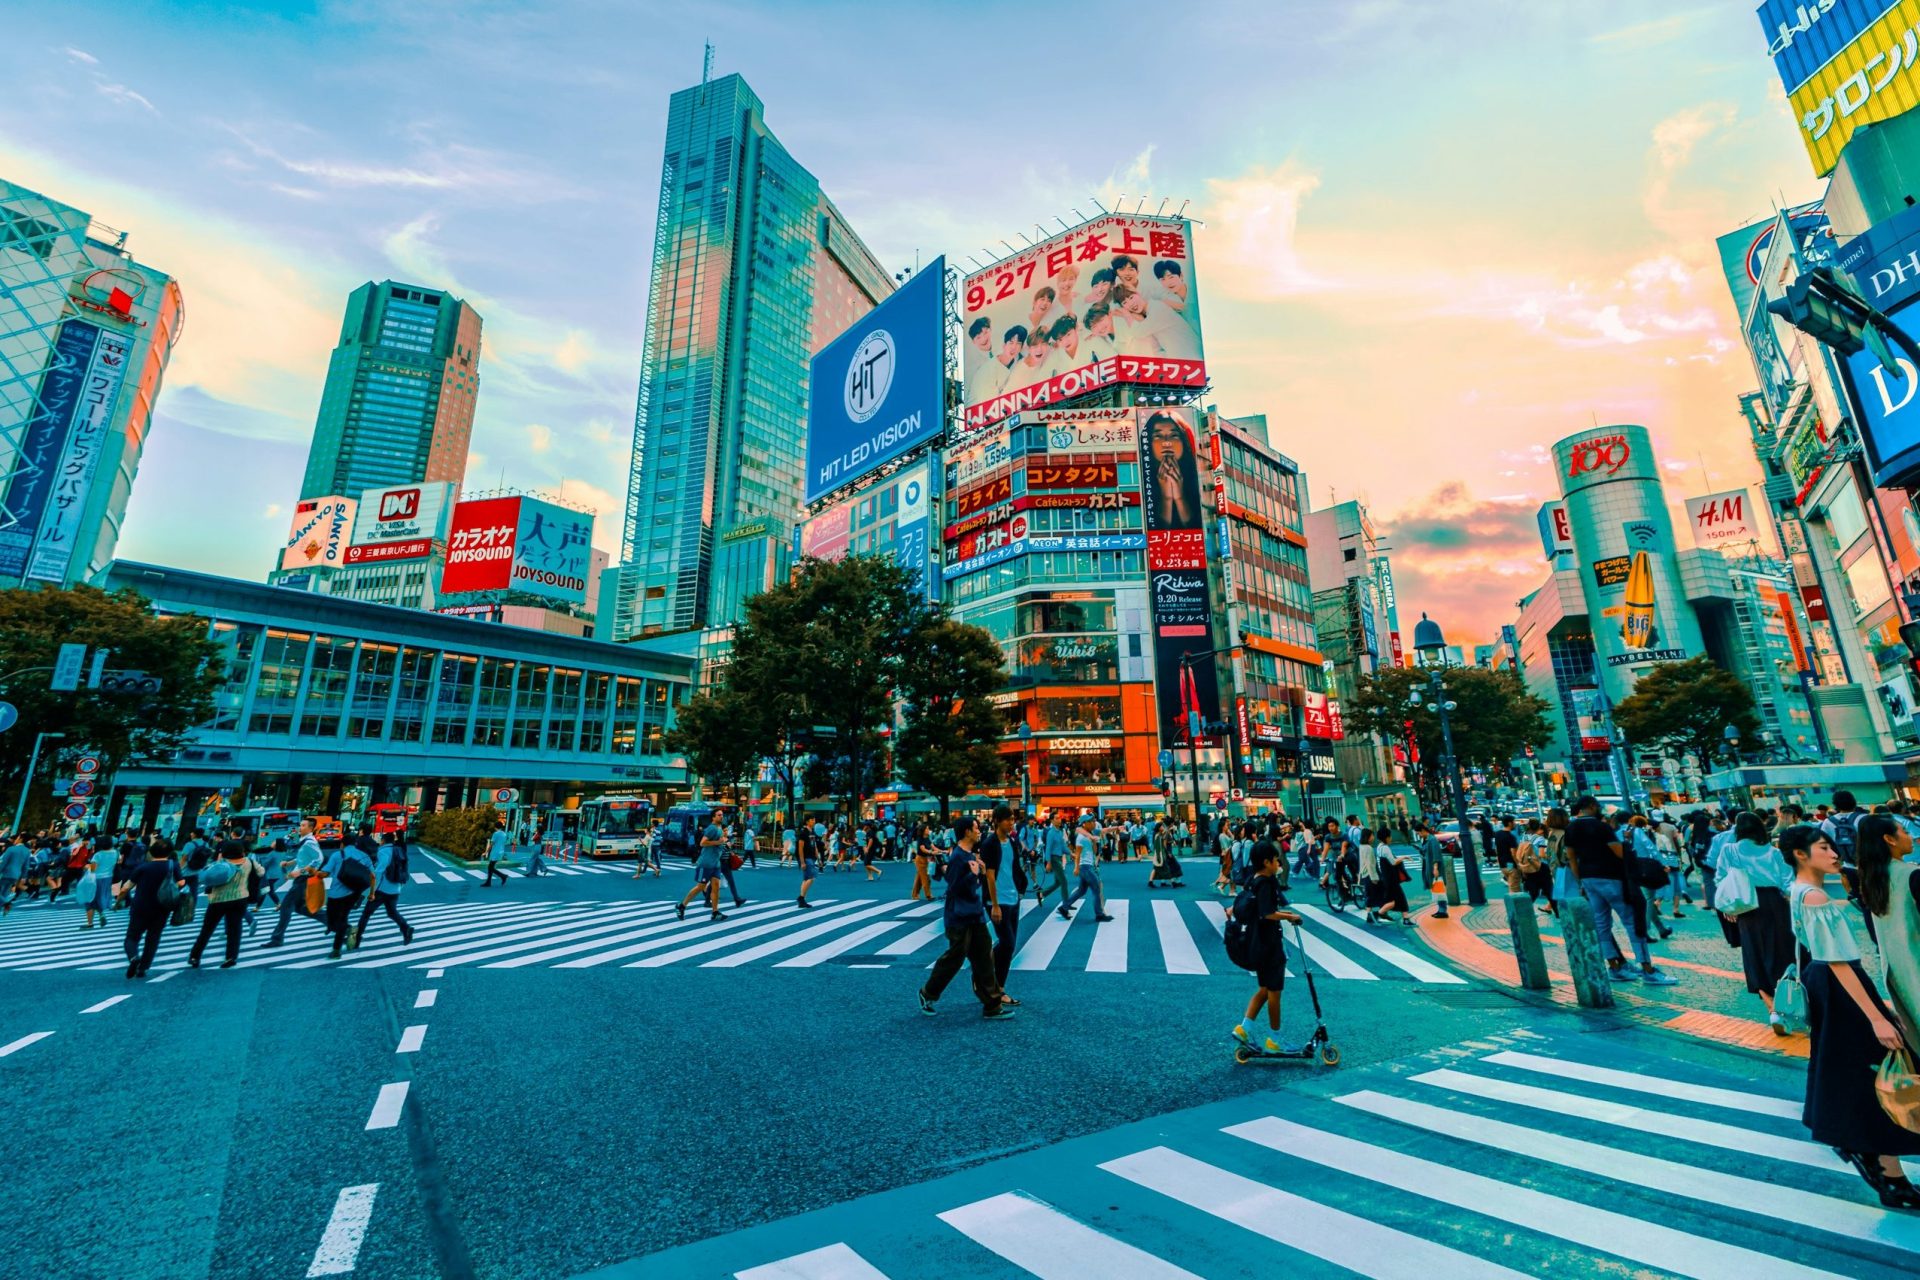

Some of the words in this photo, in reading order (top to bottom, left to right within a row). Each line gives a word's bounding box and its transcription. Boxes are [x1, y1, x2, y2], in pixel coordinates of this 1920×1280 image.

[1121, 361, 1201, 381] ワナワン
[1037, 410, 1130, 422] しゃぶしゃぶバイキング
[1078, 425, 1134, 445] しゃぶ葉
[820, 458, 841, 485] HIT
[843, 441, 870, 472] LED
[872, 410, 922, 454] VISION
[43, 376, 109, 543] ワコールビッグバザール
[1568, 443, 1630, 477] 109
[947, 469, 957, 481] 9F
[1028, 467, 1114, 484] コンタクト
[959, 478, 1011, 513] プライス
[1089, 493, 1130, 509] ガスト
[987, 503, 1015, 524] ガスト
[1697, 495, 1742, 528] H&M
[287, 505, 332, 548] SANKYO
[326, 503, 349, 560] SANKYO
[380, 527, 421, 539] MasterCard
[389, 520, 405, 529] VISA
[521, 512, 590, 551] 大声
[451, 525, 515, 550] カラオケ
[975, 528, 1008, 557] ガスト
[1034, 540, 1058, 548] AEON
[1066, 537, 1144, 549] 英会話イーオン
[1149, 531, 1203, 545] ユリゴコロ
[366, 543, 425, 558] 三菱東京UFJ銀行
[448, 545, 513, 564] JOYSOUND
[947, 547, 958, 561] 7F
[964, 547, 1012, 571] 英会話イーオン
[1380, 560, 1389, 574] BIC
[513, 565, 585, 591] JOYSOUND
[1152, 573, 1205, 593] Rihwa
[1157, 595, 1178, 604] 9.20
[1178, 595, 1203, 603] Release
[1383, 576, 1395, 609] CAMERA
[1049, 738, 1111, 750] L'OCCITANE
[1309, 755, 1336, 773] LUSH
